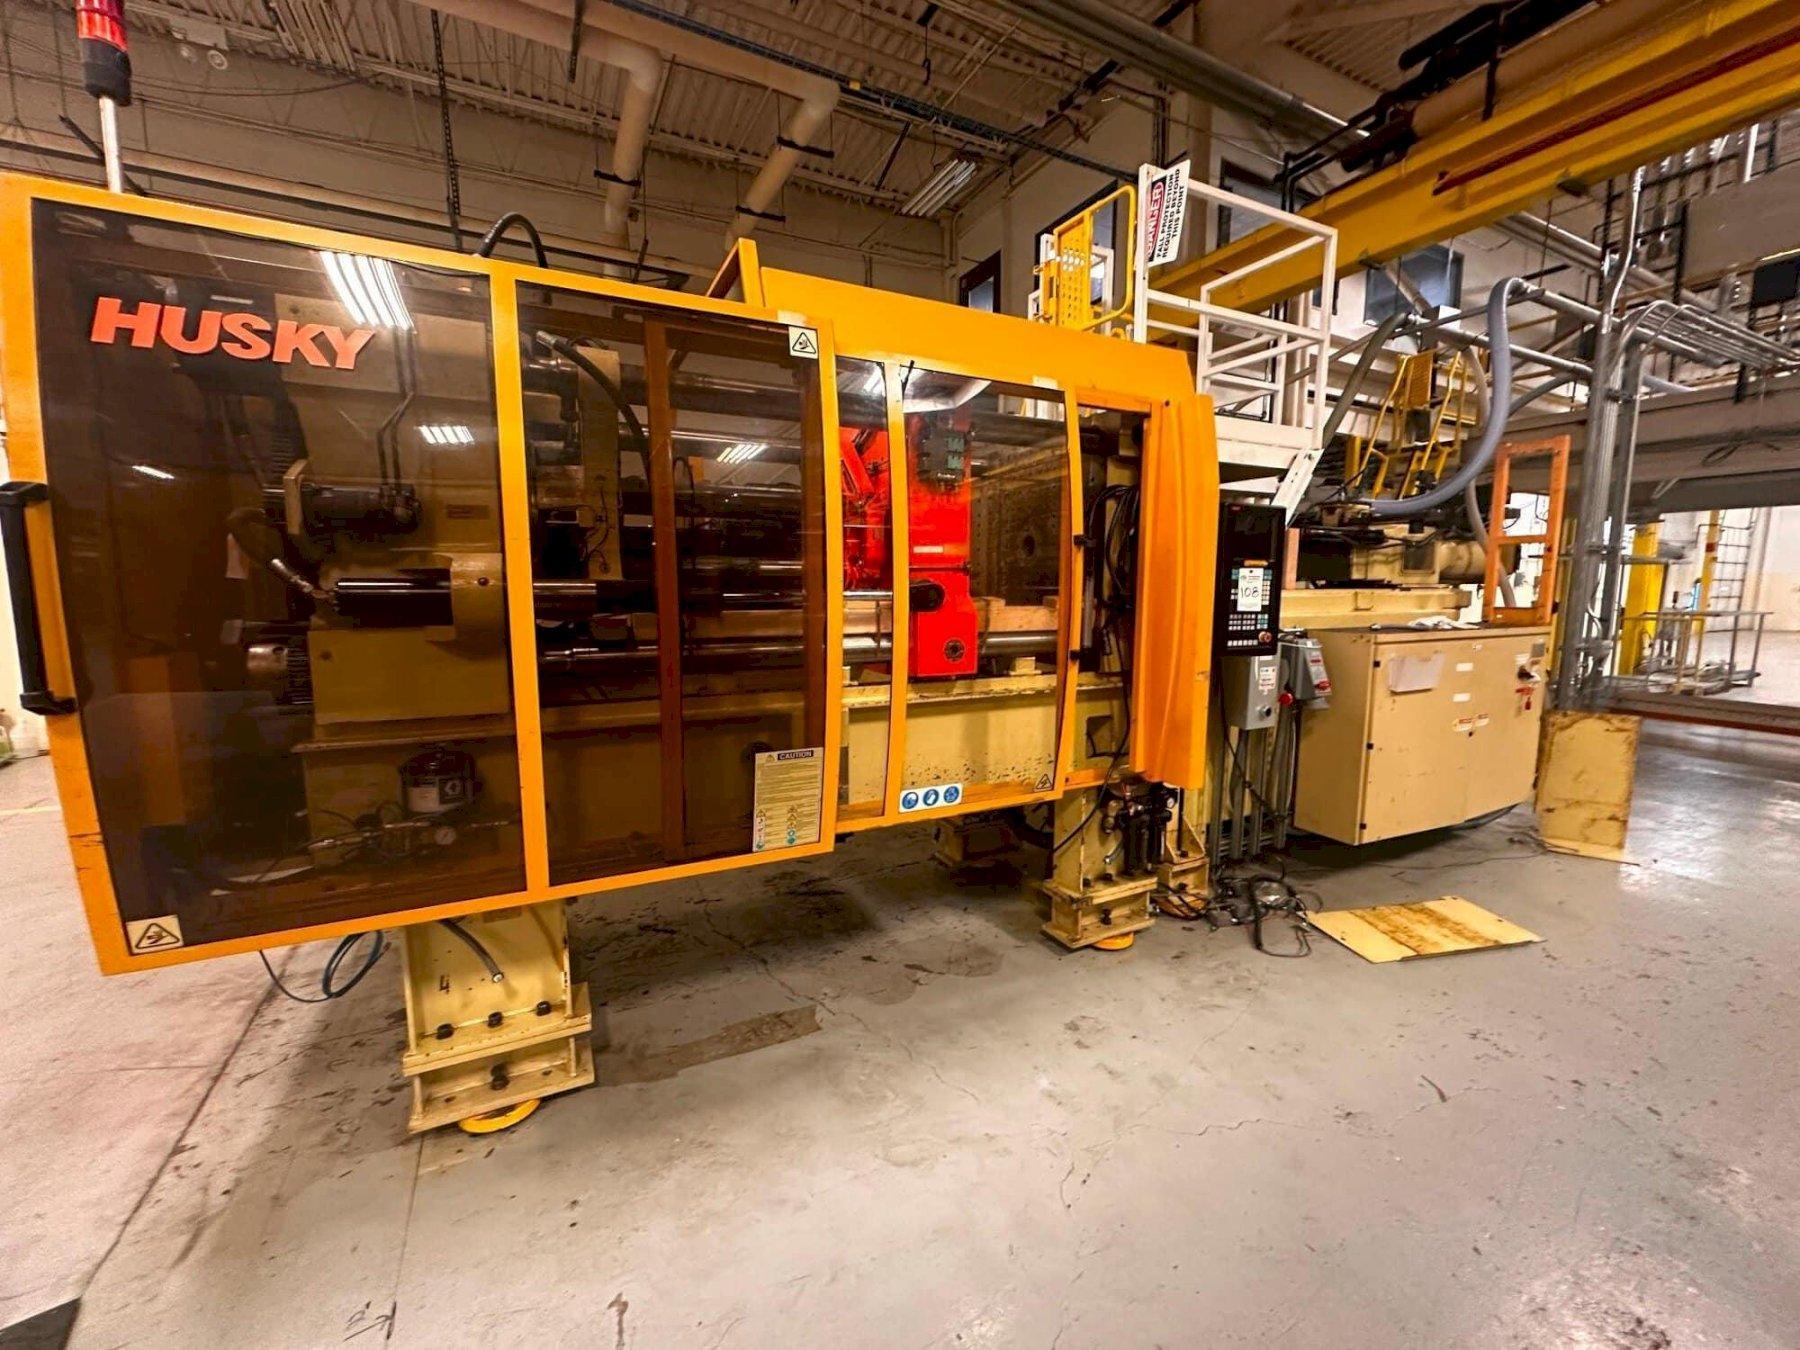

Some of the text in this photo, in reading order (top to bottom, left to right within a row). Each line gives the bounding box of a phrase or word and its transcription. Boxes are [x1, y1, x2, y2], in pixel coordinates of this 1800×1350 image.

[1157, 174, 1174, 257] FALL PROTECTION
[1162, 168, 1180, 258] REQUIRED BEYOND
[1171, 185, 1184, 239] THIS POINT
[90, 296, 377, 370] HUSKY
[1240, 586, 1260, 599] 108
[779, 751, 812, 760] CAUTION
